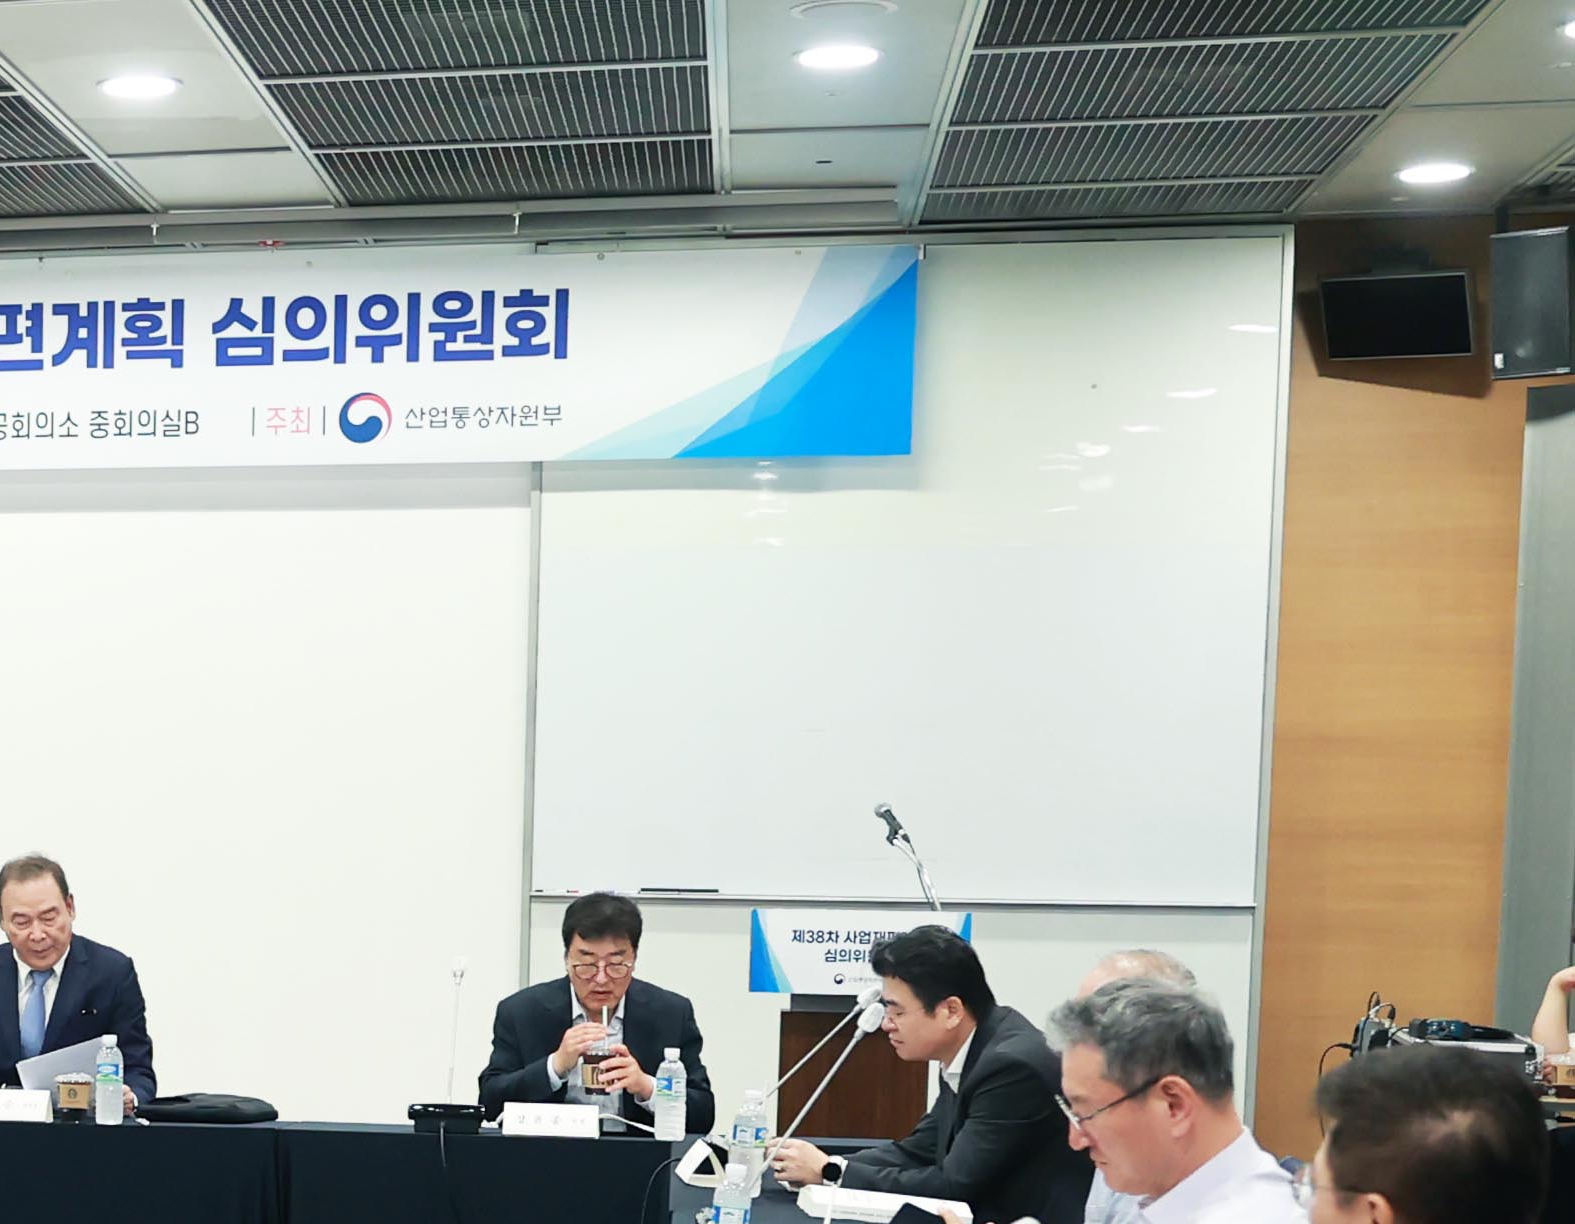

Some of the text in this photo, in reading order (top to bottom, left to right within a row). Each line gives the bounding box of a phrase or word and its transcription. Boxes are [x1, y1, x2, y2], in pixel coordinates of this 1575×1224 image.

[211, 287, 571, 368] 심의위원회
[88, 408, 200, 439] 중회의실B
[265, 406, 311, 436] 주최
[404, 404, 563, 430] 산업통상자원부
[791, 929, 840, 945] 제38차
[824, 948, 872, 963] 심의위
